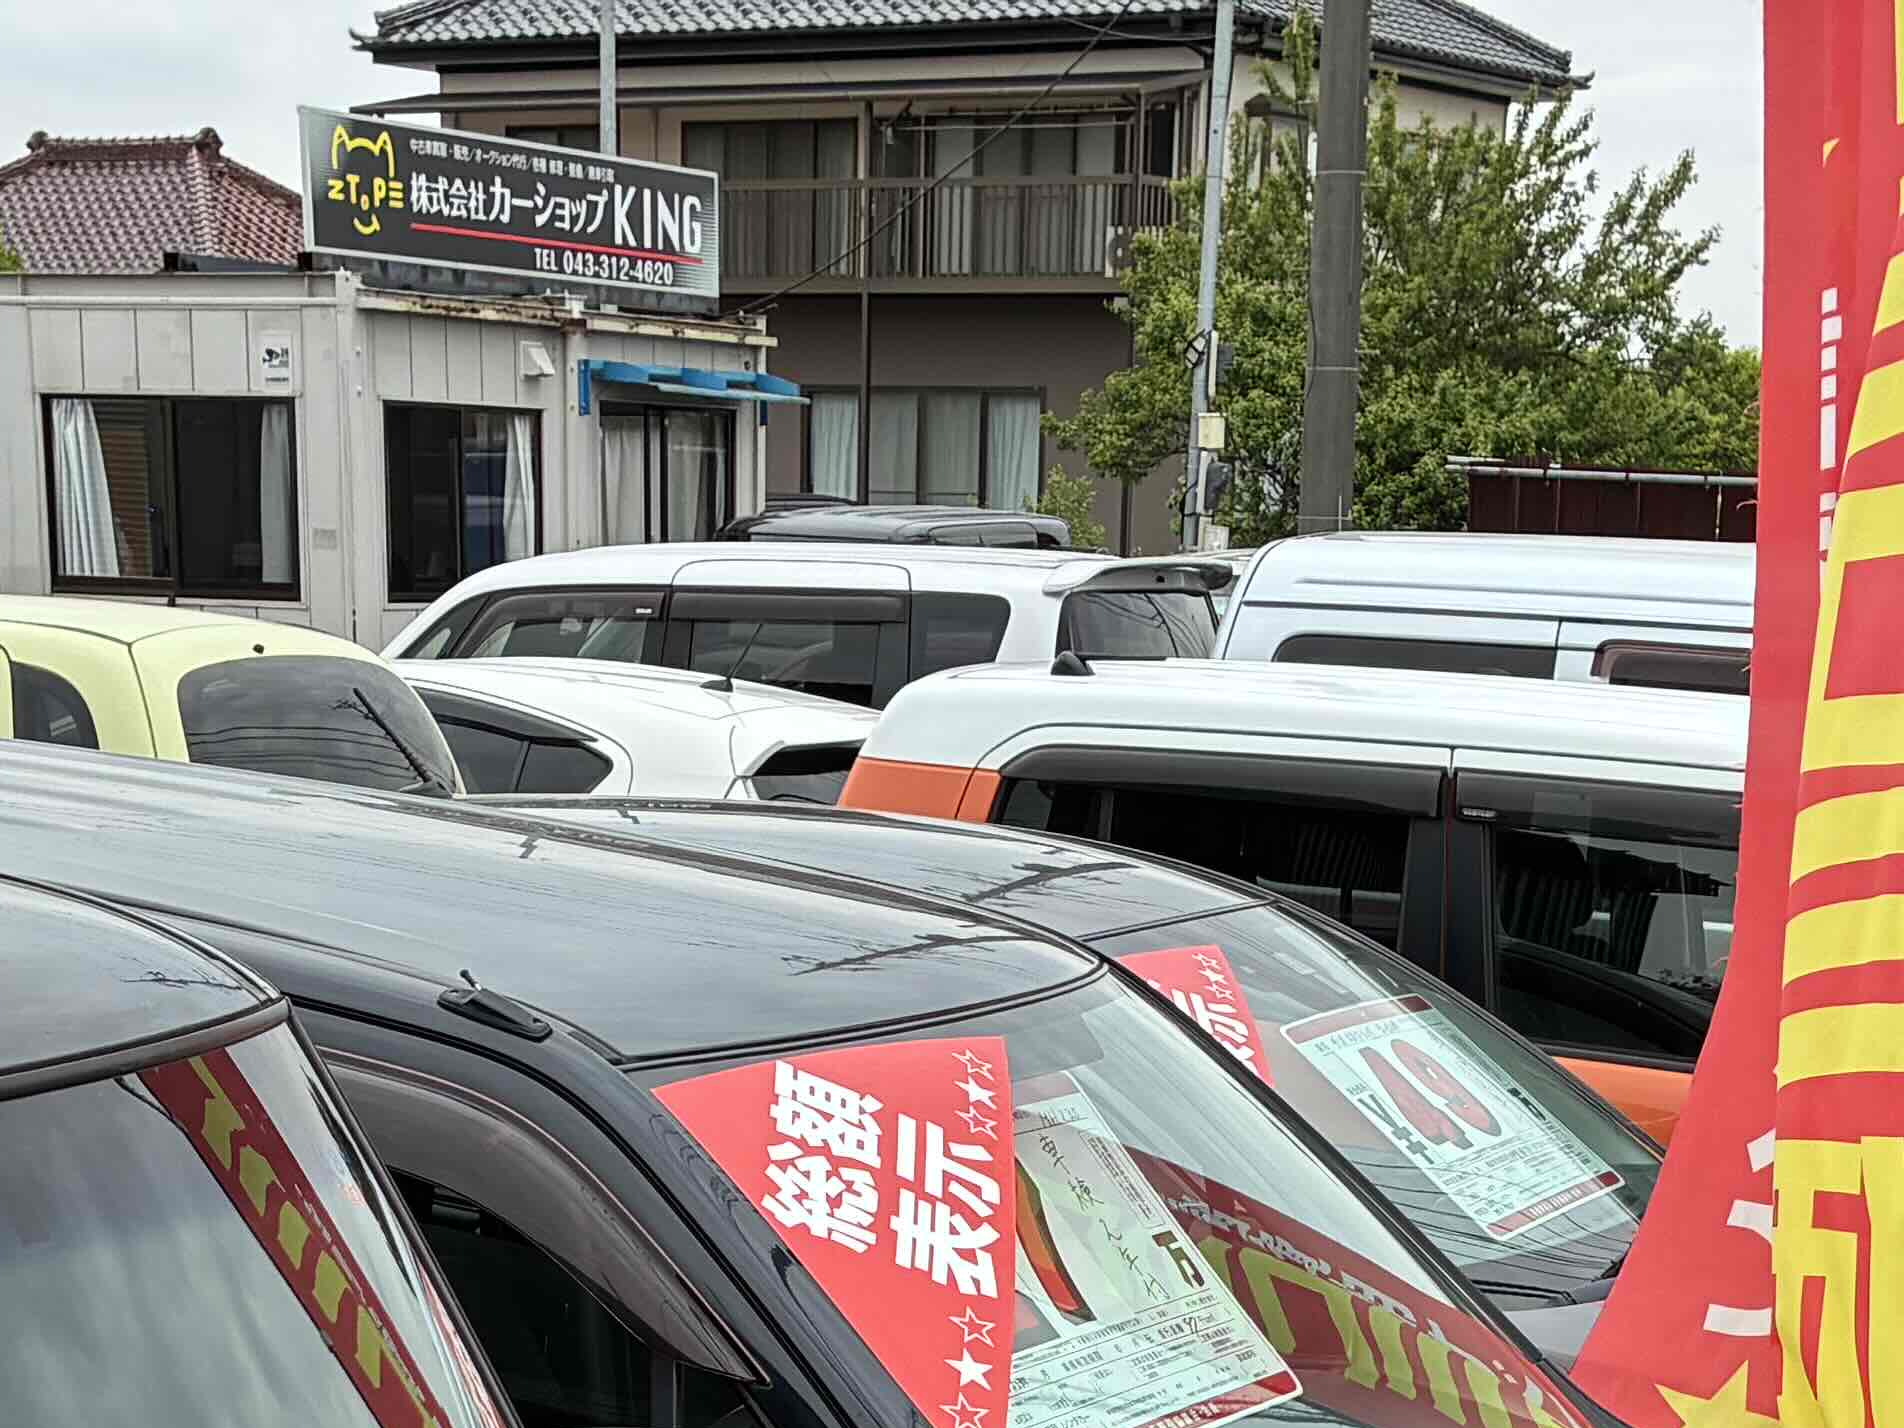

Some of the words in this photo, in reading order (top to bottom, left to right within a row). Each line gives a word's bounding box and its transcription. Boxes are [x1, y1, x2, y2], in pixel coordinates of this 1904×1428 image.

[410, 172, 609, 233] 株式会社カーショップ
[614, 183, 701, 254] KING
[534, 248, 559, 271] TEL
[563, 252, 674, 285] 043-312-4620
[762, 1061, 885, 1253] 総額
[889, 1114, 1002, 1298] 表示
[1151, 1229, 1204, 1291] 万
